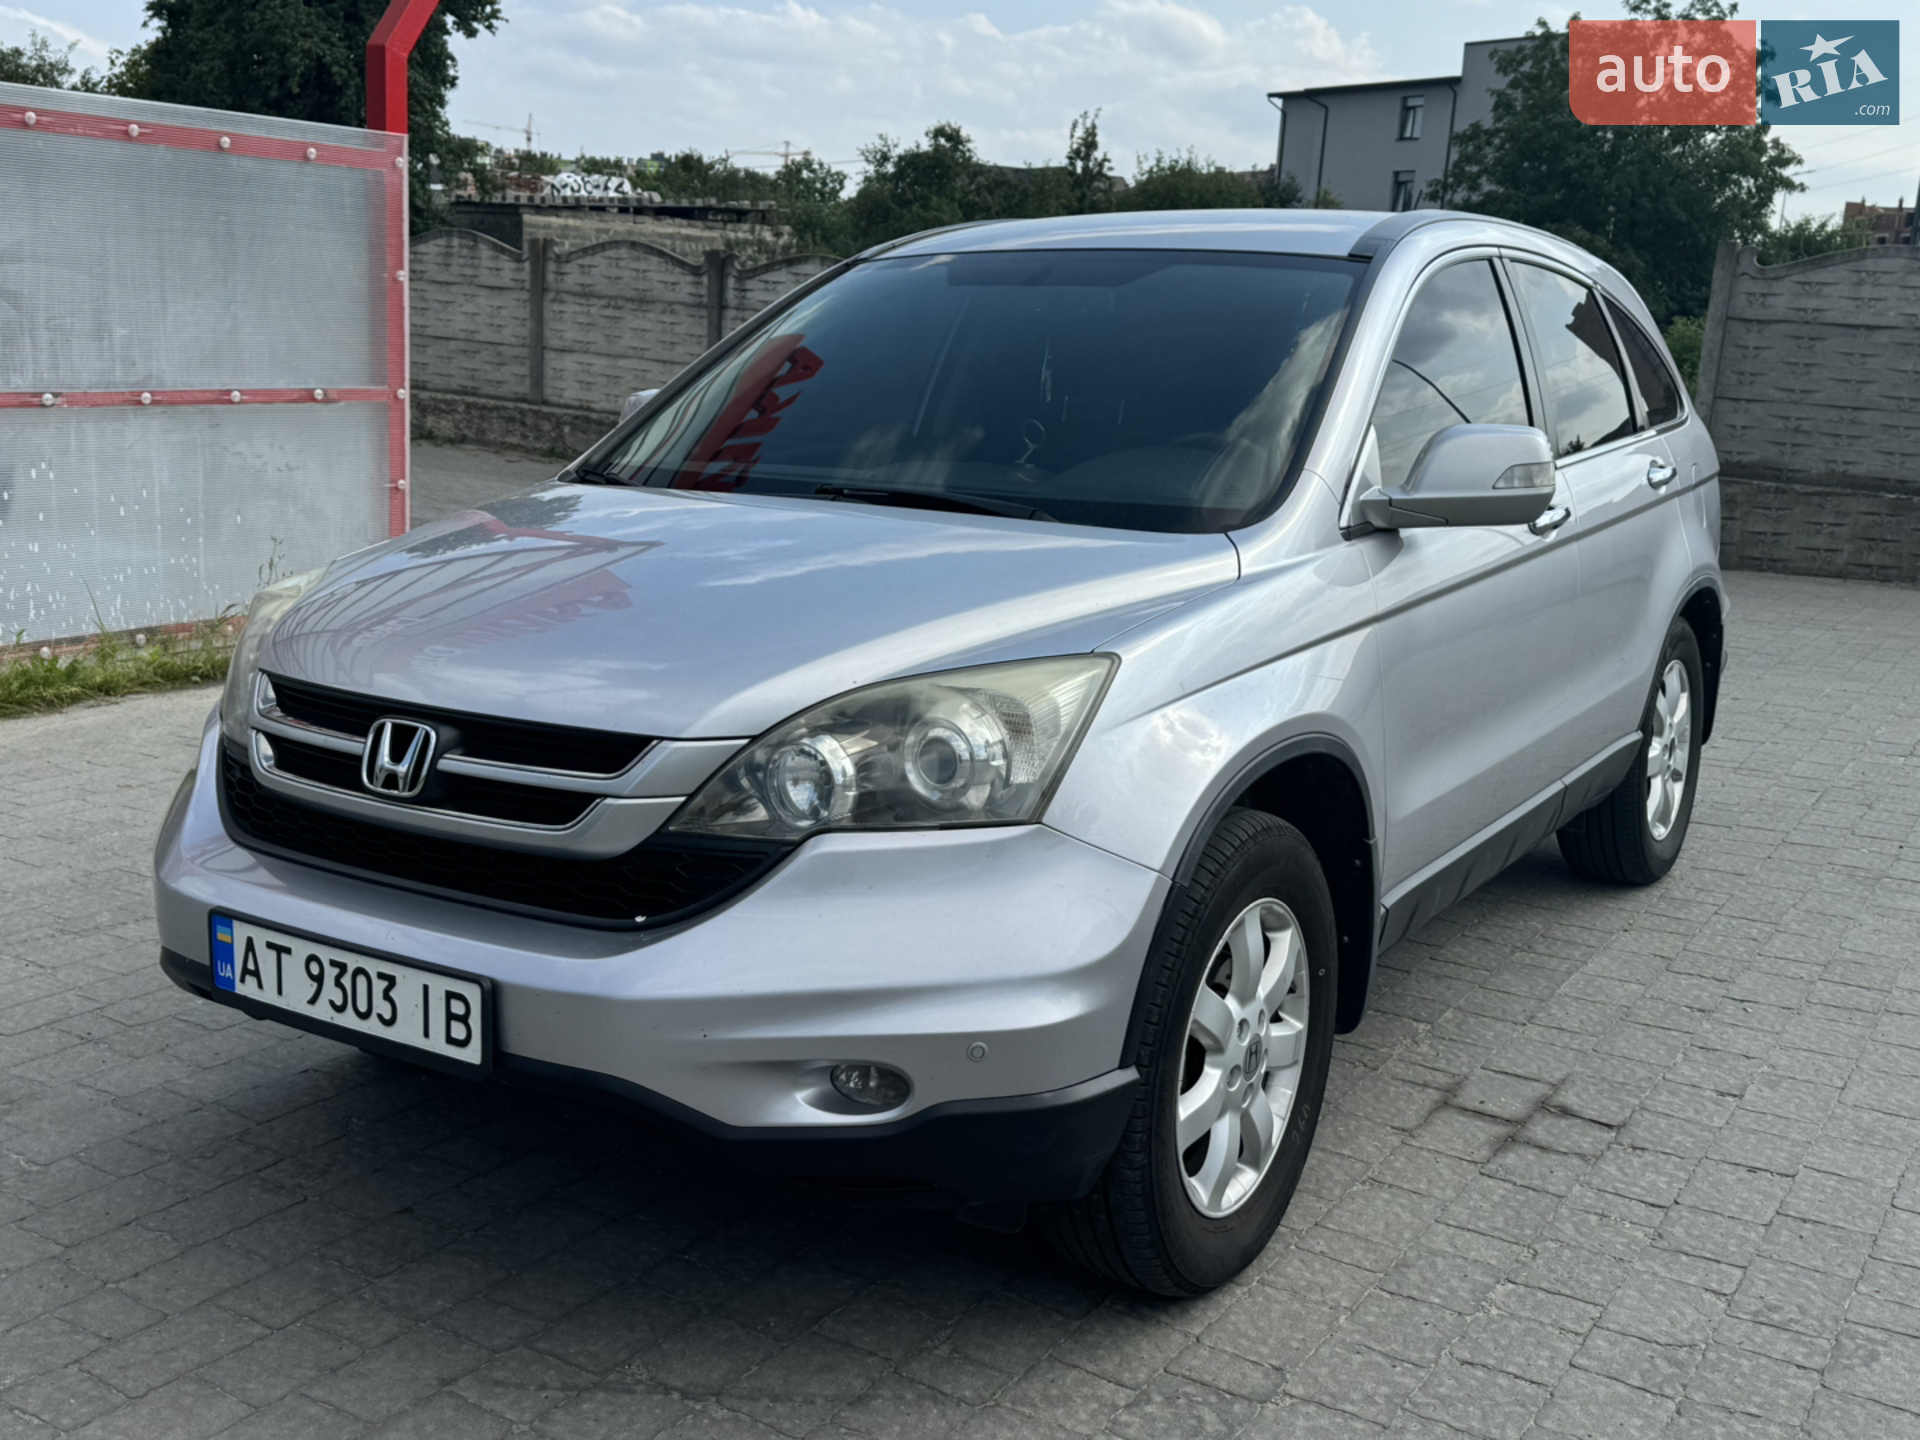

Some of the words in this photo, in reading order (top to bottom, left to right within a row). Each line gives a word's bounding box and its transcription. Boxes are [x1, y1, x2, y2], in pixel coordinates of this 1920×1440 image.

[217, 960, 234, 980] UA
[239, 936, 292, 996] AT
[304, 953, 398, 1027] 9303
[423, 983, 473, 1048] IB
